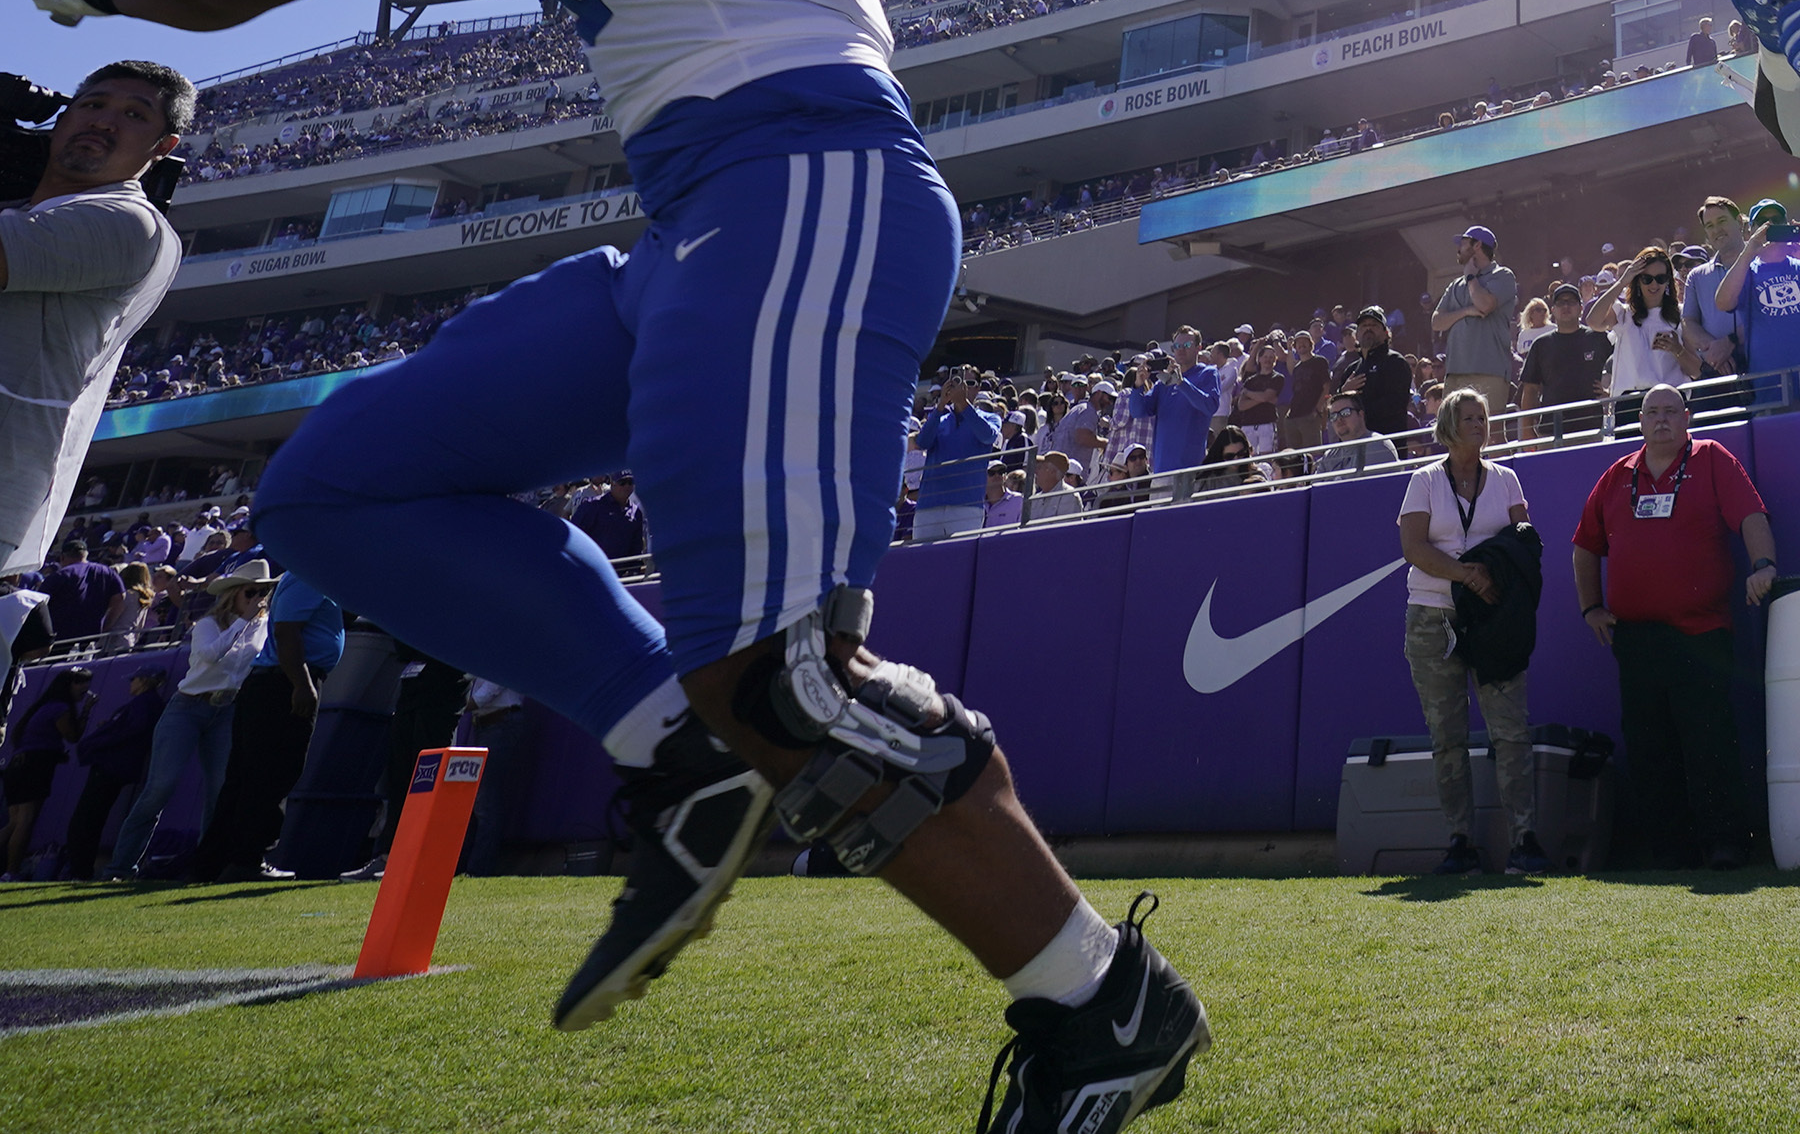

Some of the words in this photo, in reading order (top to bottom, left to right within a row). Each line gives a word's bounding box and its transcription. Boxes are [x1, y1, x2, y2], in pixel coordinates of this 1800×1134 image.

[1342, 32, 1394, 61] PEACH
[1399, 20, 1447, 48] BOWL
[493, 90, 523, 105] DELTA
[1124, 88, 1162, 112] ROSE
[1167, 78, 1211, 104] BOWL
[460, 205, 572, 245] WELCOME
[581, 198, 610, 225] TO
[248, 254, 290, 274] SUGAR
[292, 250, 327, 269] BOWL
[448, 760, 480, 778] TCU
